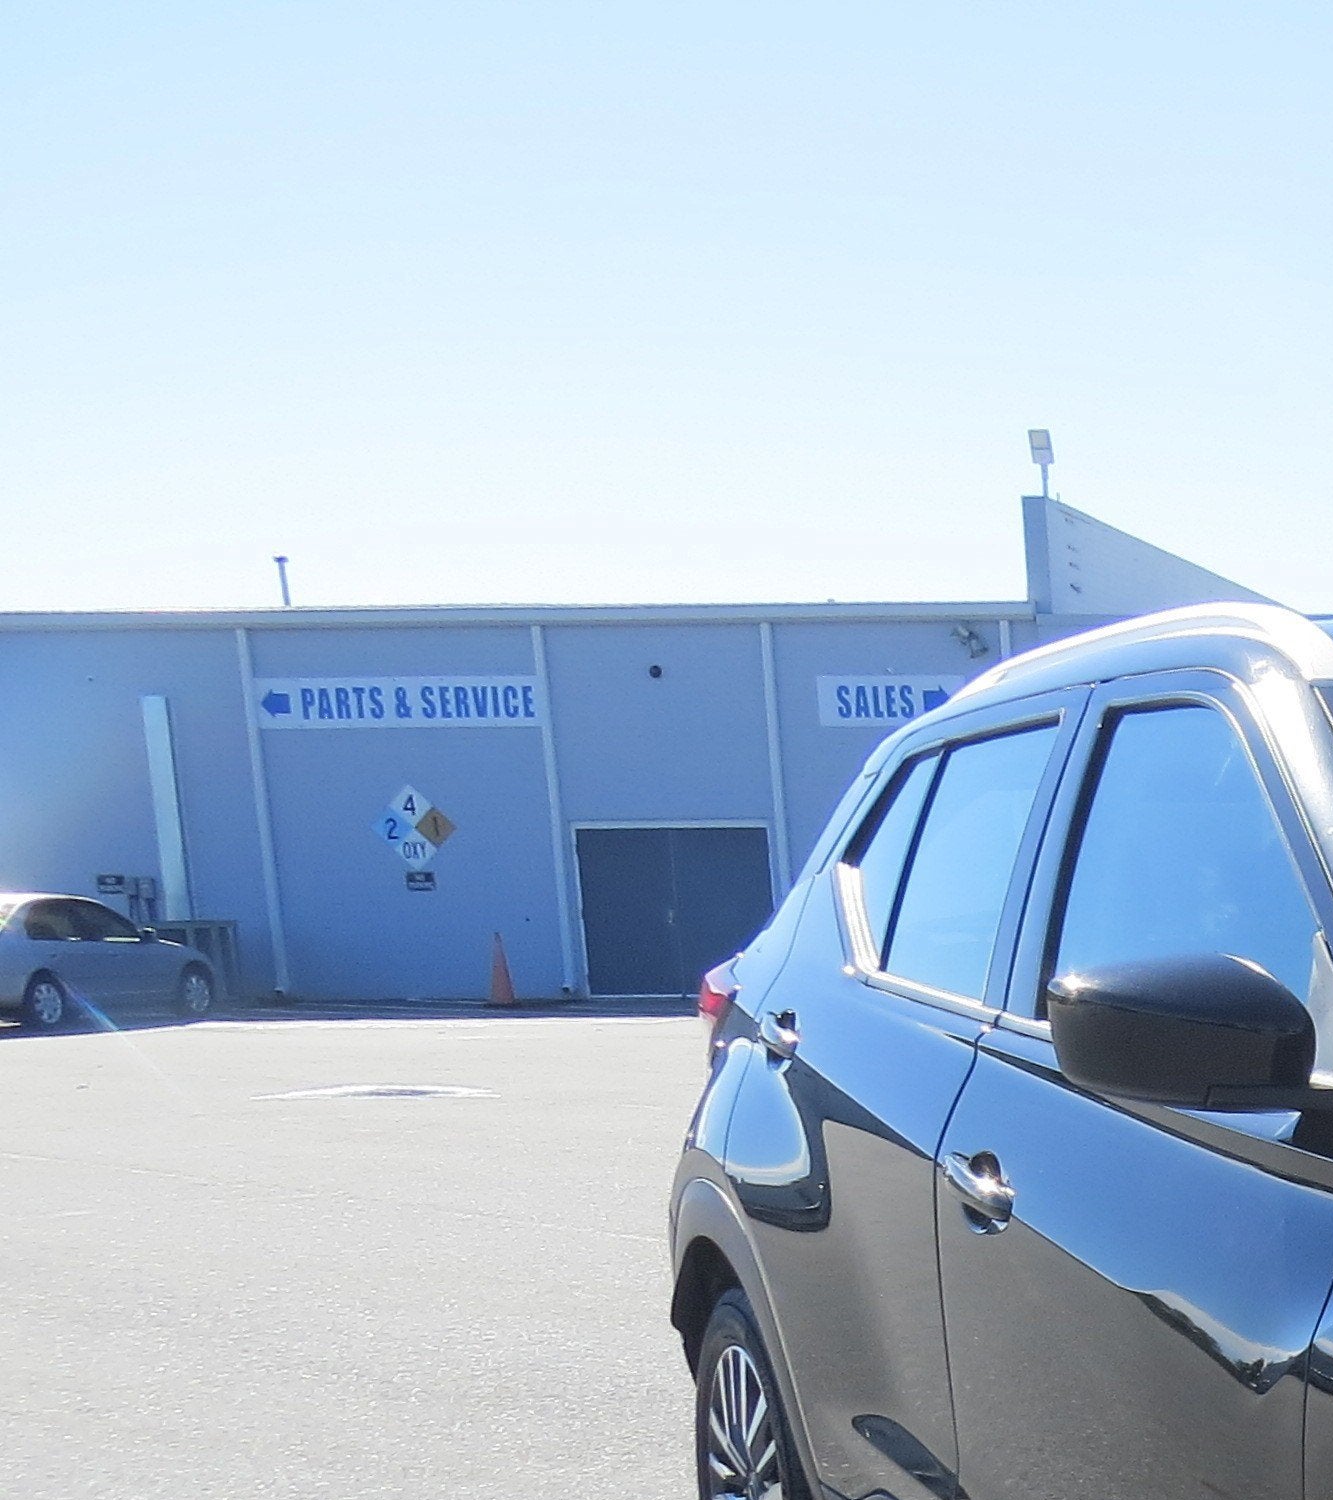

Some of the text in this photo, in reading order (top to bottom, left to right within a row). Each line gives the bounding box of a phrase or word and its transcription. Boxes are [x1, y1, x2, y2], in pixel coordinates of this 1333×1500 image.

[301, 685, 536, 719] PARTS & SERVICE
[836, 684, 915, 719] SALES
[402, 794, 416, 816] 4
[384, 818, 400, 840] 2
[402, 841, 427, 859] OXY
